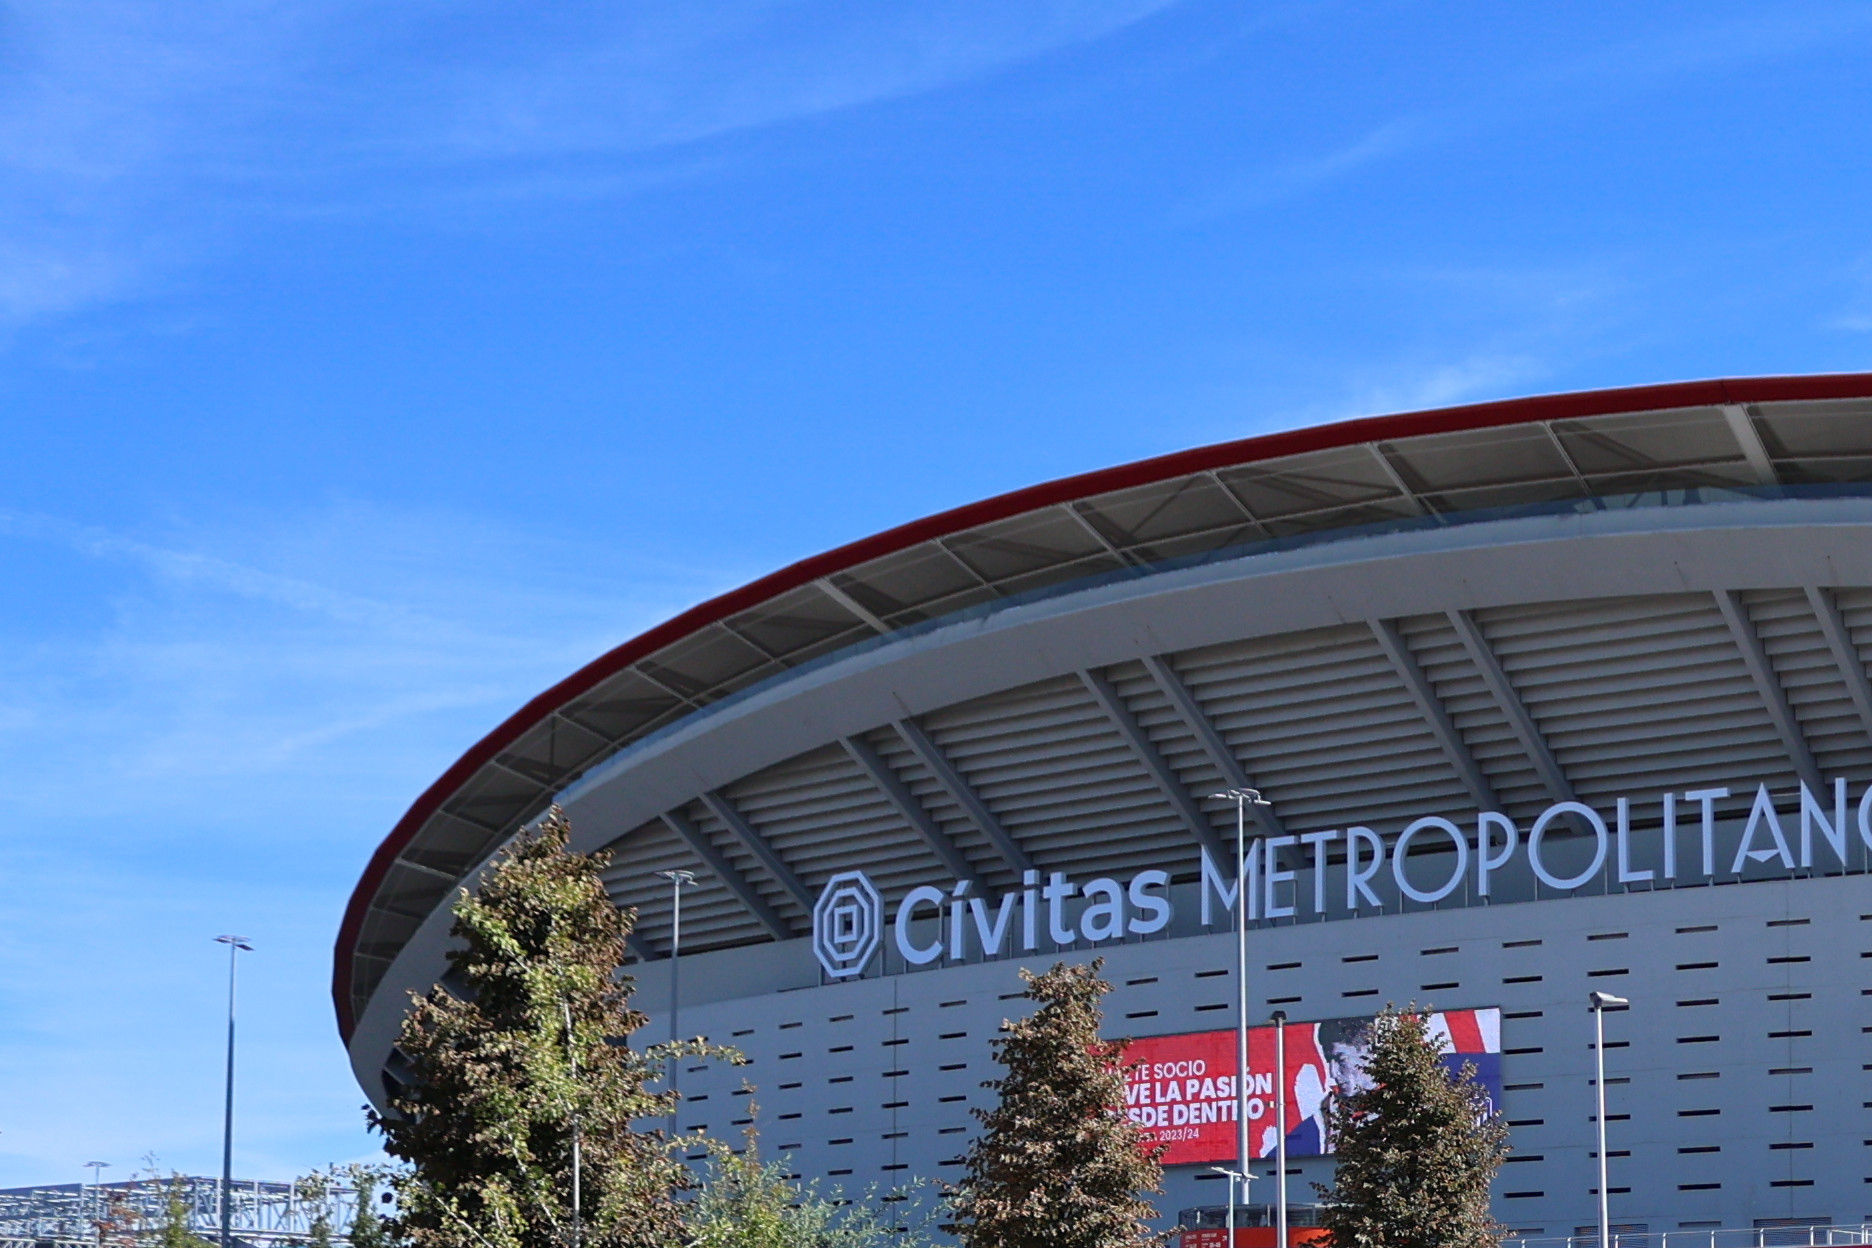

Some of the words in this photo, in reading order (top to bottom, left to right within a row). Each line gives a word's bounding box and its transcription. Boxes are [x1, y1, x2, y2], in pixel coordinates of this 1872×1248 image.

[895, 869, 1173, 966] Cívitas
[1153, 1060, 1206, 1080] SOCIO
[1155, 1080, 1182, 1104] LA
[1159, 1127, 1200, 1143] 2023/24
